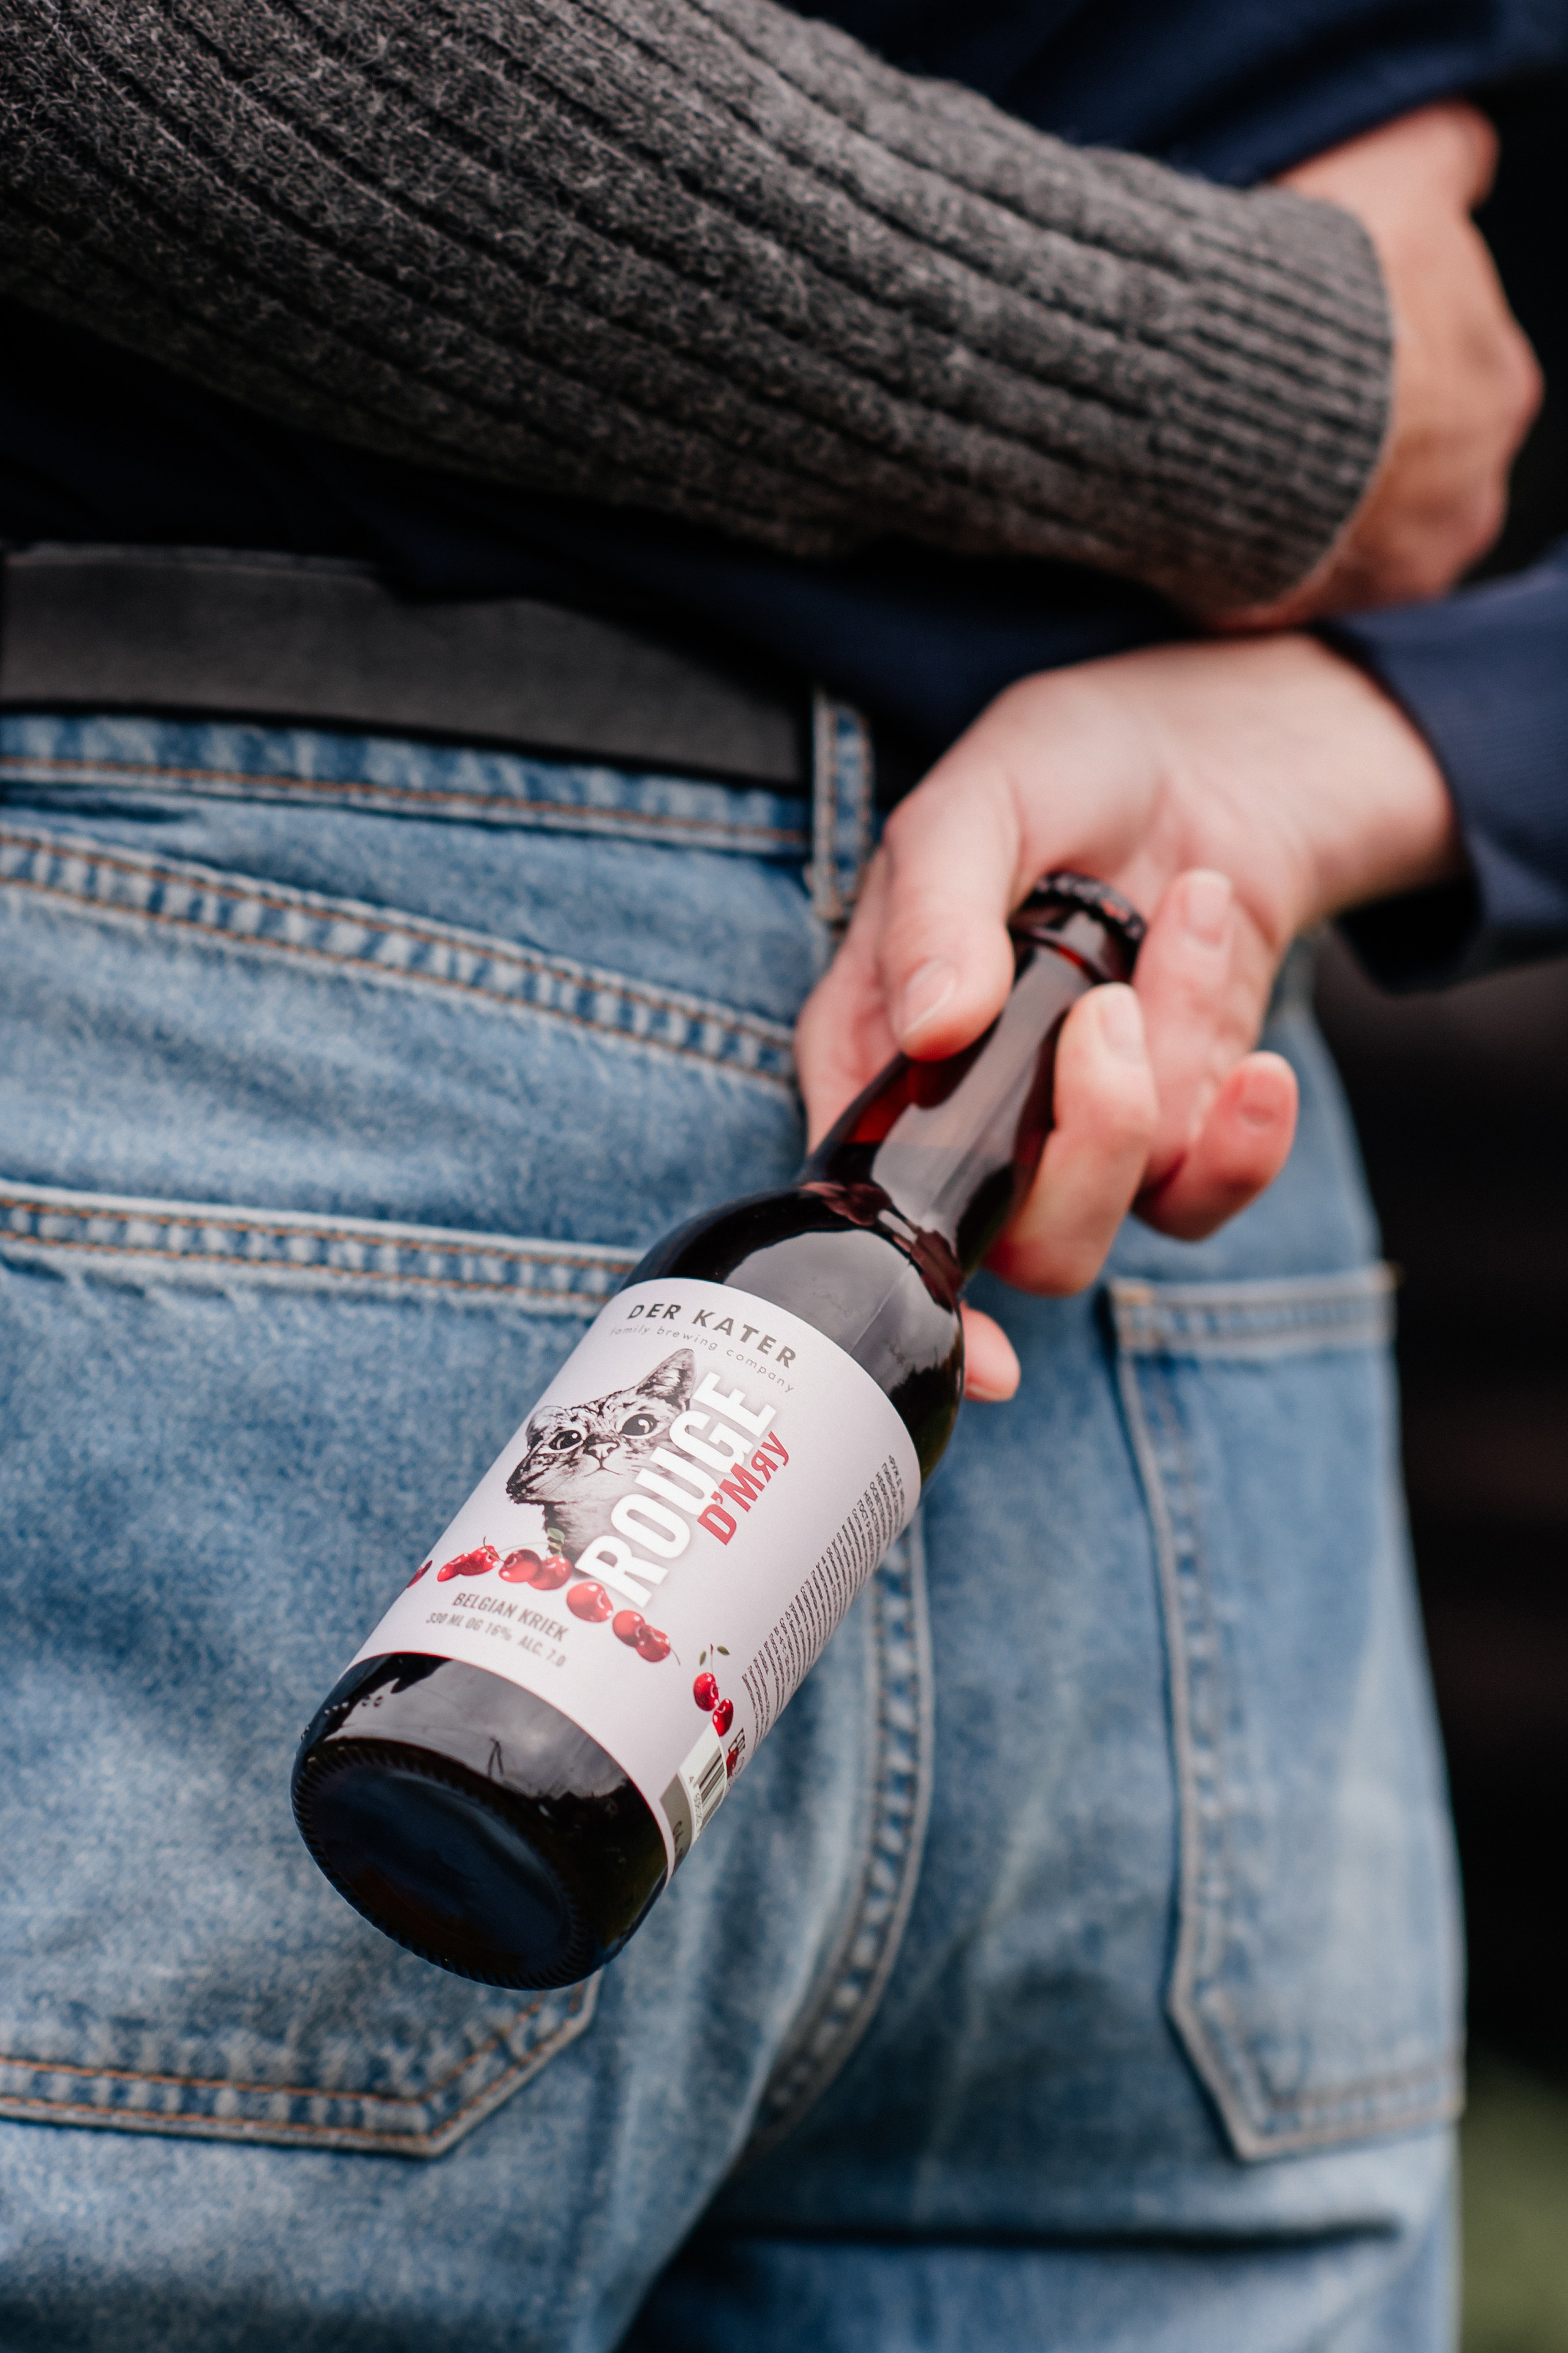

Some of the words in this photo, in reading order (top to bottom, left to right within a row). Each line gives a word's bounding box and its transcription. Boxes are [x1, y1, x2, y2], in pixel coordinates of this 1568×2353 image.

[609, 1324, 650, 1335] family
[657, 1326, 718, 1351] brewing
[726, 1349, 795, 1392] company
[627, 1303, 682, 1320] DER
[692, 1309, 796, 1369] KATER
[575, 1371, 777, 1608] ROUGE
[452, 1593, 518, 1618] BELGIAN
[518, 1609, 568, 1642] KRIEK
